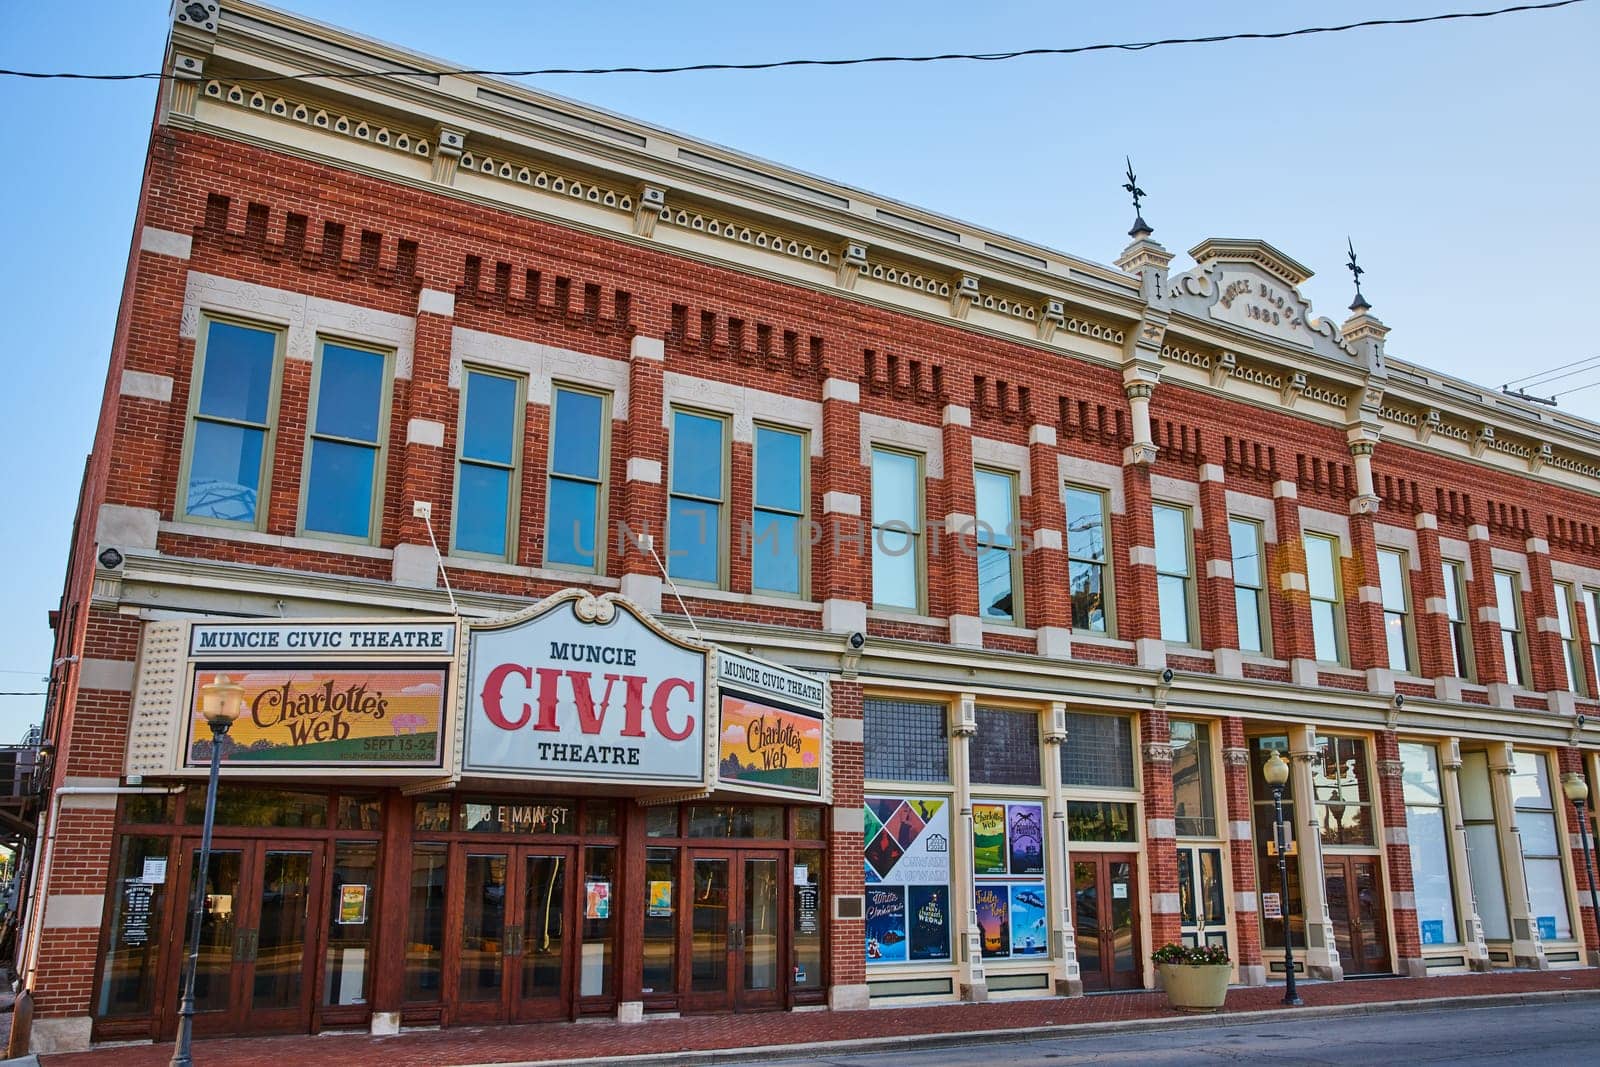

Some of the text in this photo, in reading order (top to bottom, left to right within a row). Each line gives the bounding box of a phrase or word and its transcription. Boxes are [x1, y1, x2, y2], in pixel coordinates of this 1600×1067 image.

[200, 631, 444, 648] MUNCIE CIVIC THEATRE
[550, 641, 637, 667] MUNCIE
[724, 660, 822, 701] MUNCIE CIVIC THEATRE
[251, 678, 389, 729] Charlotte's
[480, 663, 695, 742] CIVIC
[285, 711, 351, 746] Web
[746, 713, 802, 754] Charlotte's
[363, 738, 437, 751] SEPT 15-24
[537, 742, 640, 766] THEATRE
[762, 746, 788, 771] Web
[498, 806, 506, 822] E
[512, 806, 545, 824] MAIN
[551, 808, 569, 825] ST
